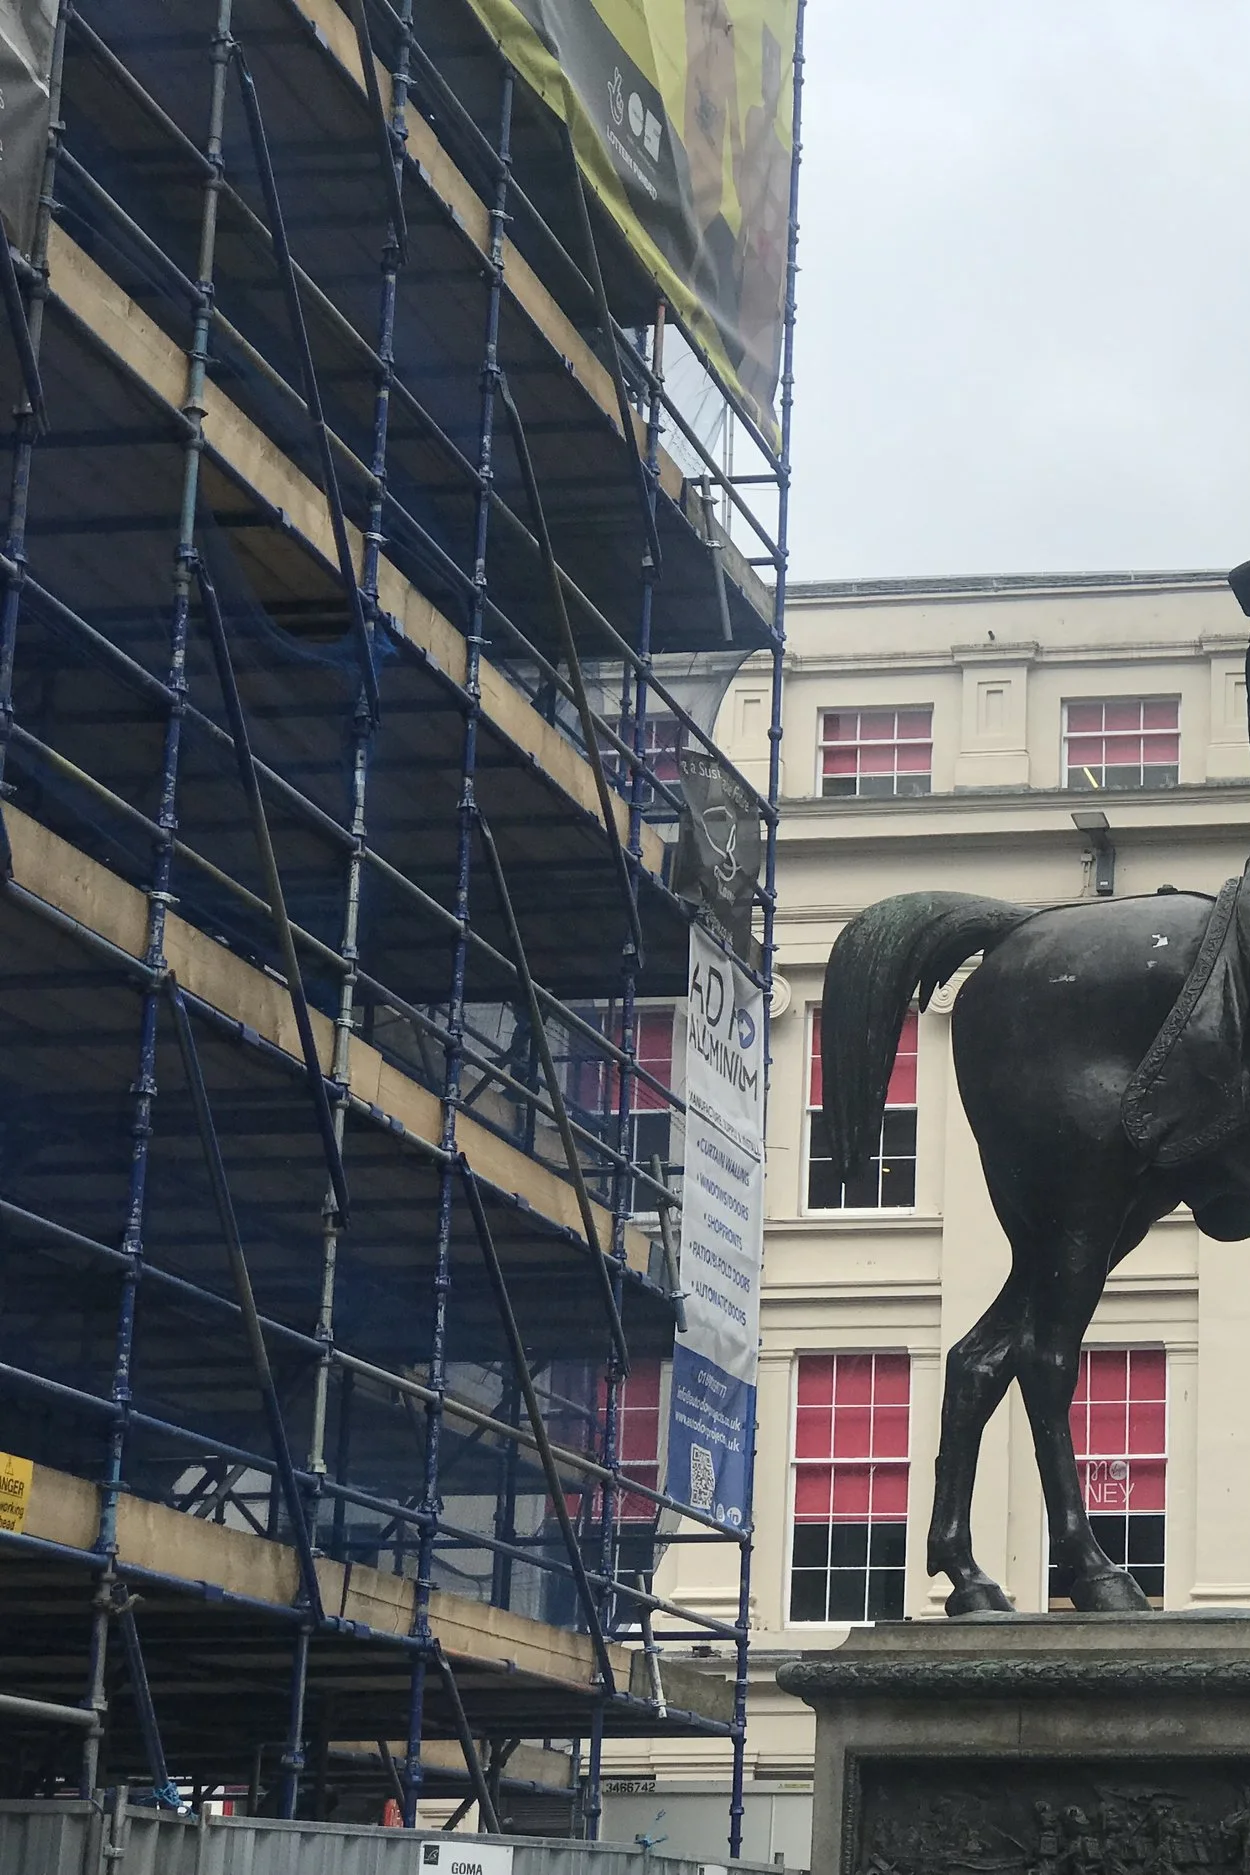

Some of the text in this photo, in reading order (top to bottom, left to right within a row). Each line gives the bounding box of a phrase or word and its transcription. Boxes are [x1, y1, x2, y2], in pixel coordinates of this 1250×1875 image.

[606, 125, 633, 171] LOTTERY
[632, 163, 658, 201] FUNDED
[688, 1013, 758, 1101] ALUMINIUM
[451, 1862, 483, 1875] GOMA
